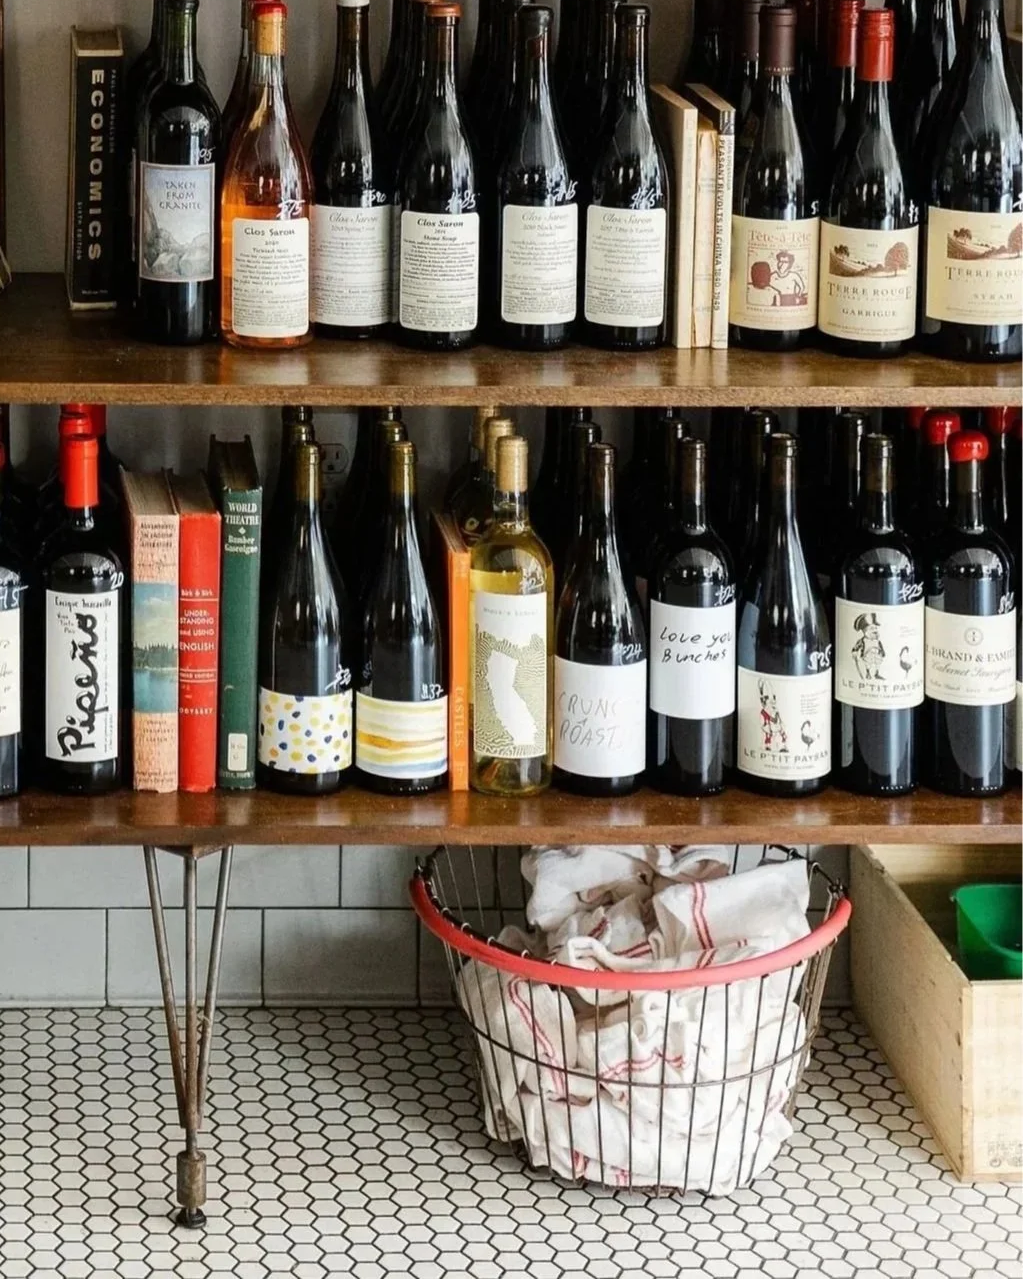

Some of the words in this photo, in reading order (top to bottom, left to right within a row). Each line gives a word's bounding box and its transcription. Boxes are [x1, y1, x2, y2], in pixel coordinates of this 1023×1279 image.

[88, 69, 105, 261] ECONOMICS
[717, 139, 725, 182] PEASANT
[716, 184, 724, 223] REVOLTS
[417, 218, 437, 227] Clos
[439, 218, 464, 227] Saron
[244, 227, 263, 237] Clos
[266, 227, 295, 237] Saron
[716, 225, 723, 235] IN
[715, 237, 723, 265] CHINA
[228, 502, 258, 513] WORLD
[225, 514, 259, 525] THEATRE
[660, 626, 702, 644] Love
[179, 642, 215, 651] ENGLISH
[662, 648, 727, 664] Bunches
[842, 679, 856, 689] LE
[858, 682, 889, 692] P'TIT
